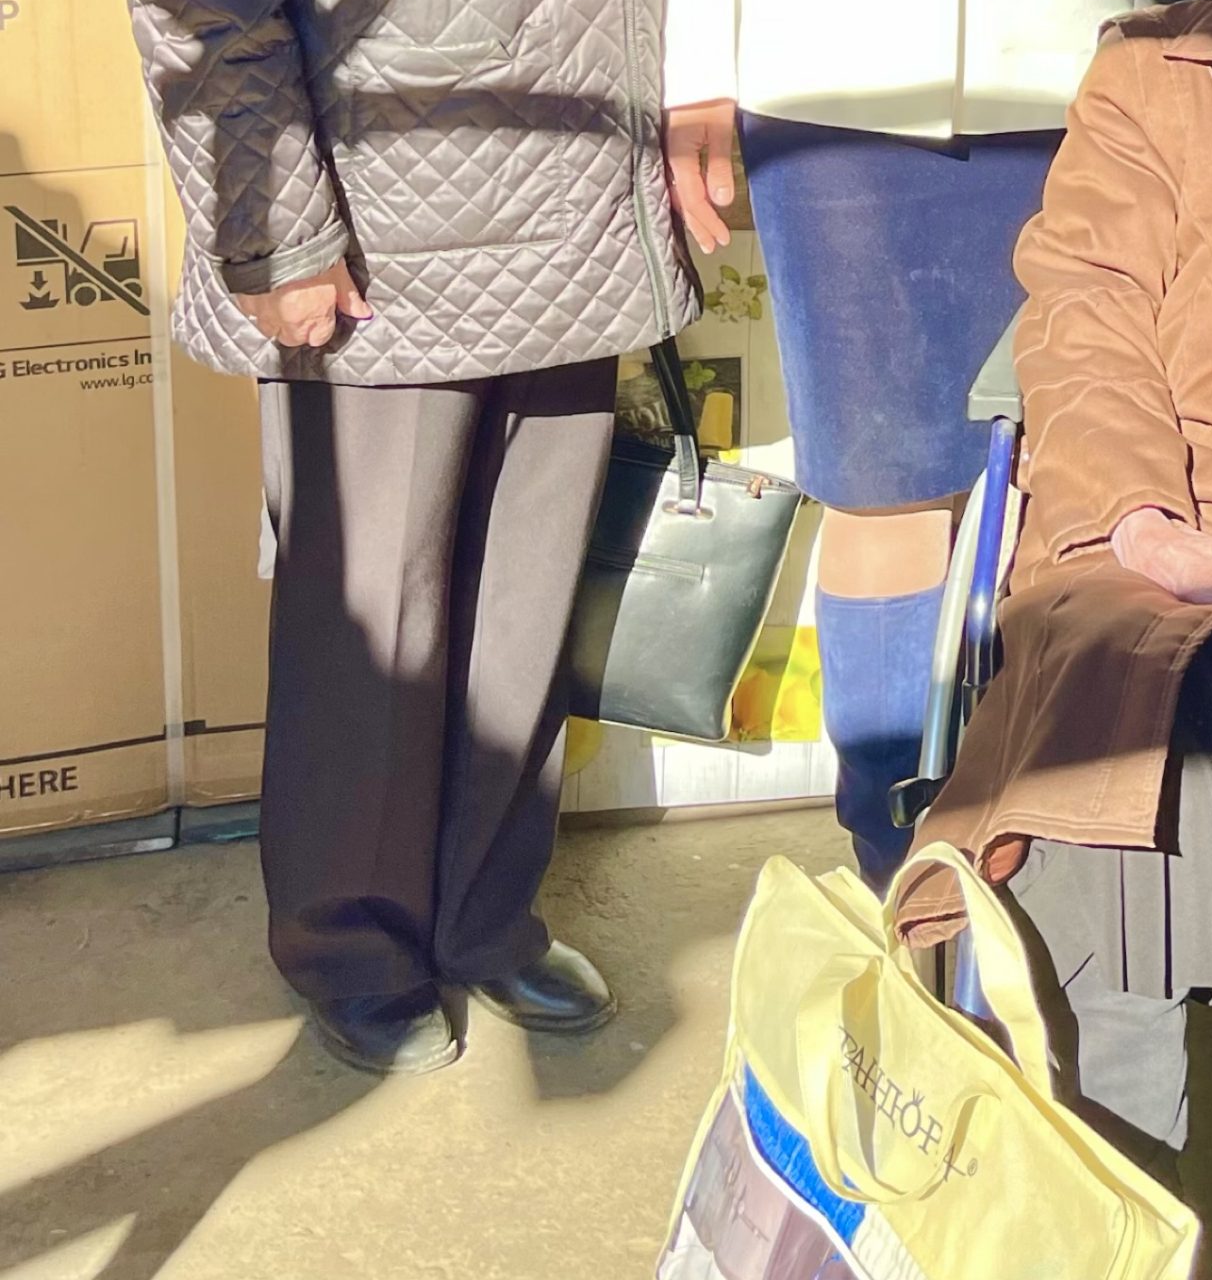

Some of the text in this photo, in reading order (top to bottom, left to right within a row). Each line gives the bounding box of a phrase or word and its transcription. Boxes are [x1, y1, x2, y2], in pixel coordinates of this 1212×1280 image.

[12, 351, 130, 377] Electronics
[134, 348, 163, 366] In
[80, 372, 163, 390] www.lg.co
